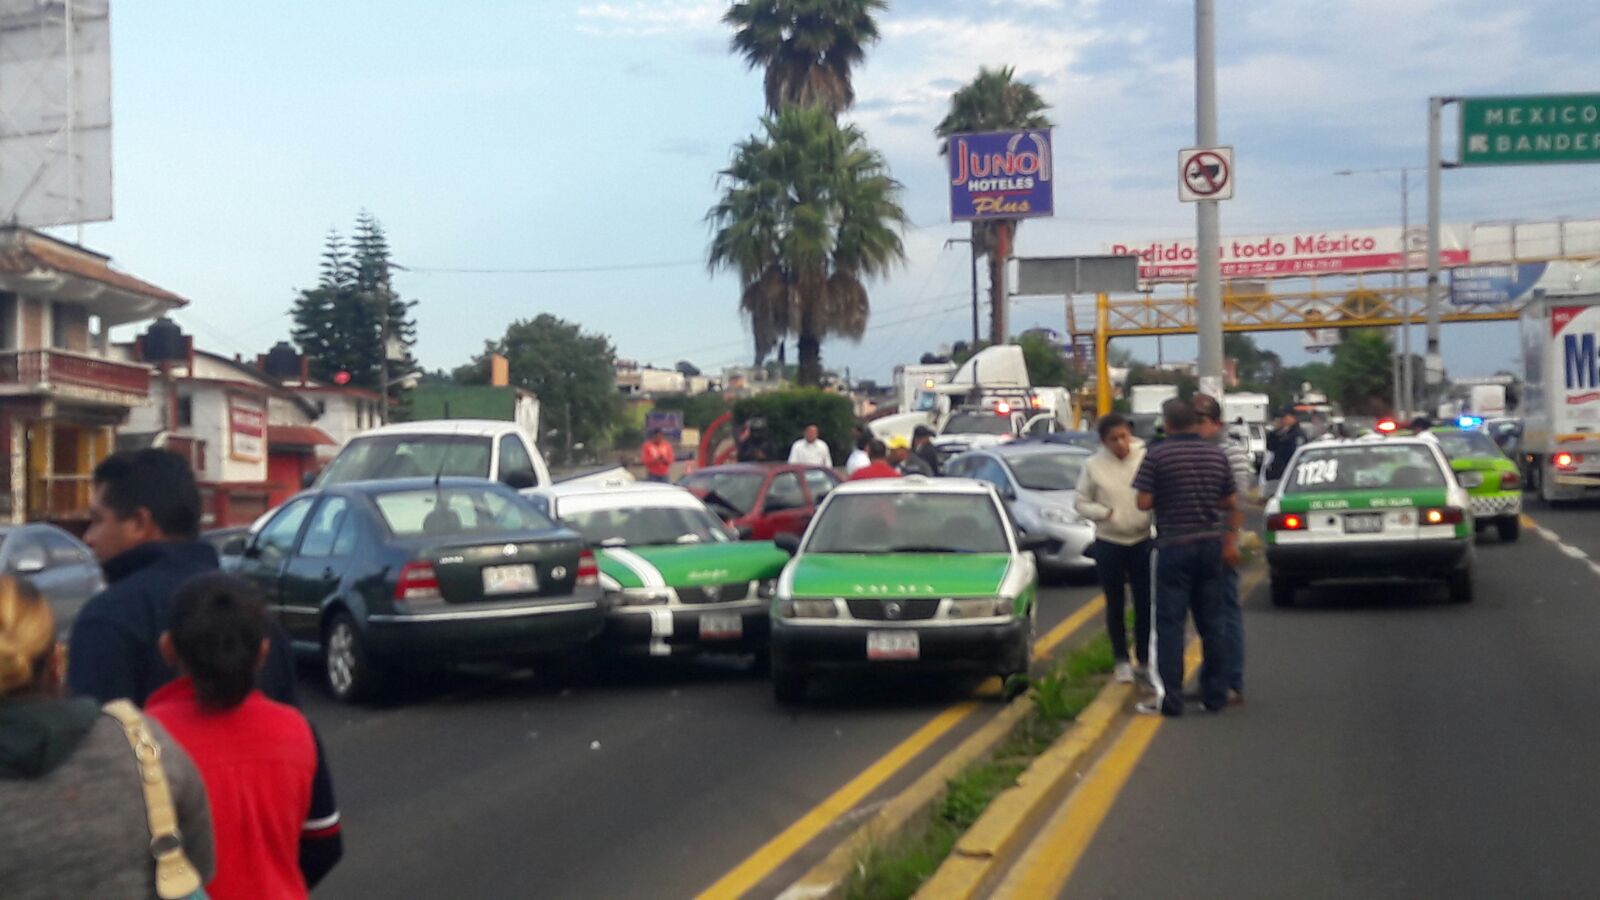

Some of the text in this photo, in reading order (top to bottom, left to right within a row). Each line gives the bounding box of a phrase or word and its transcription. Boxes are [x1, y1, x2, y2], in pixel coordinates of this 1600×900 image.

[1485, 106, 1597, 125] MEXICO
[968, 178, 1034, 192] HOTELES
[972, 195, 1030, 214] Plus
[1233, 237, 1285, 258] todo
[1293, 234, 1376, 254] México
[1564, 332, 1600, 390] M
[1297, 459, 1339, 485] 1124
